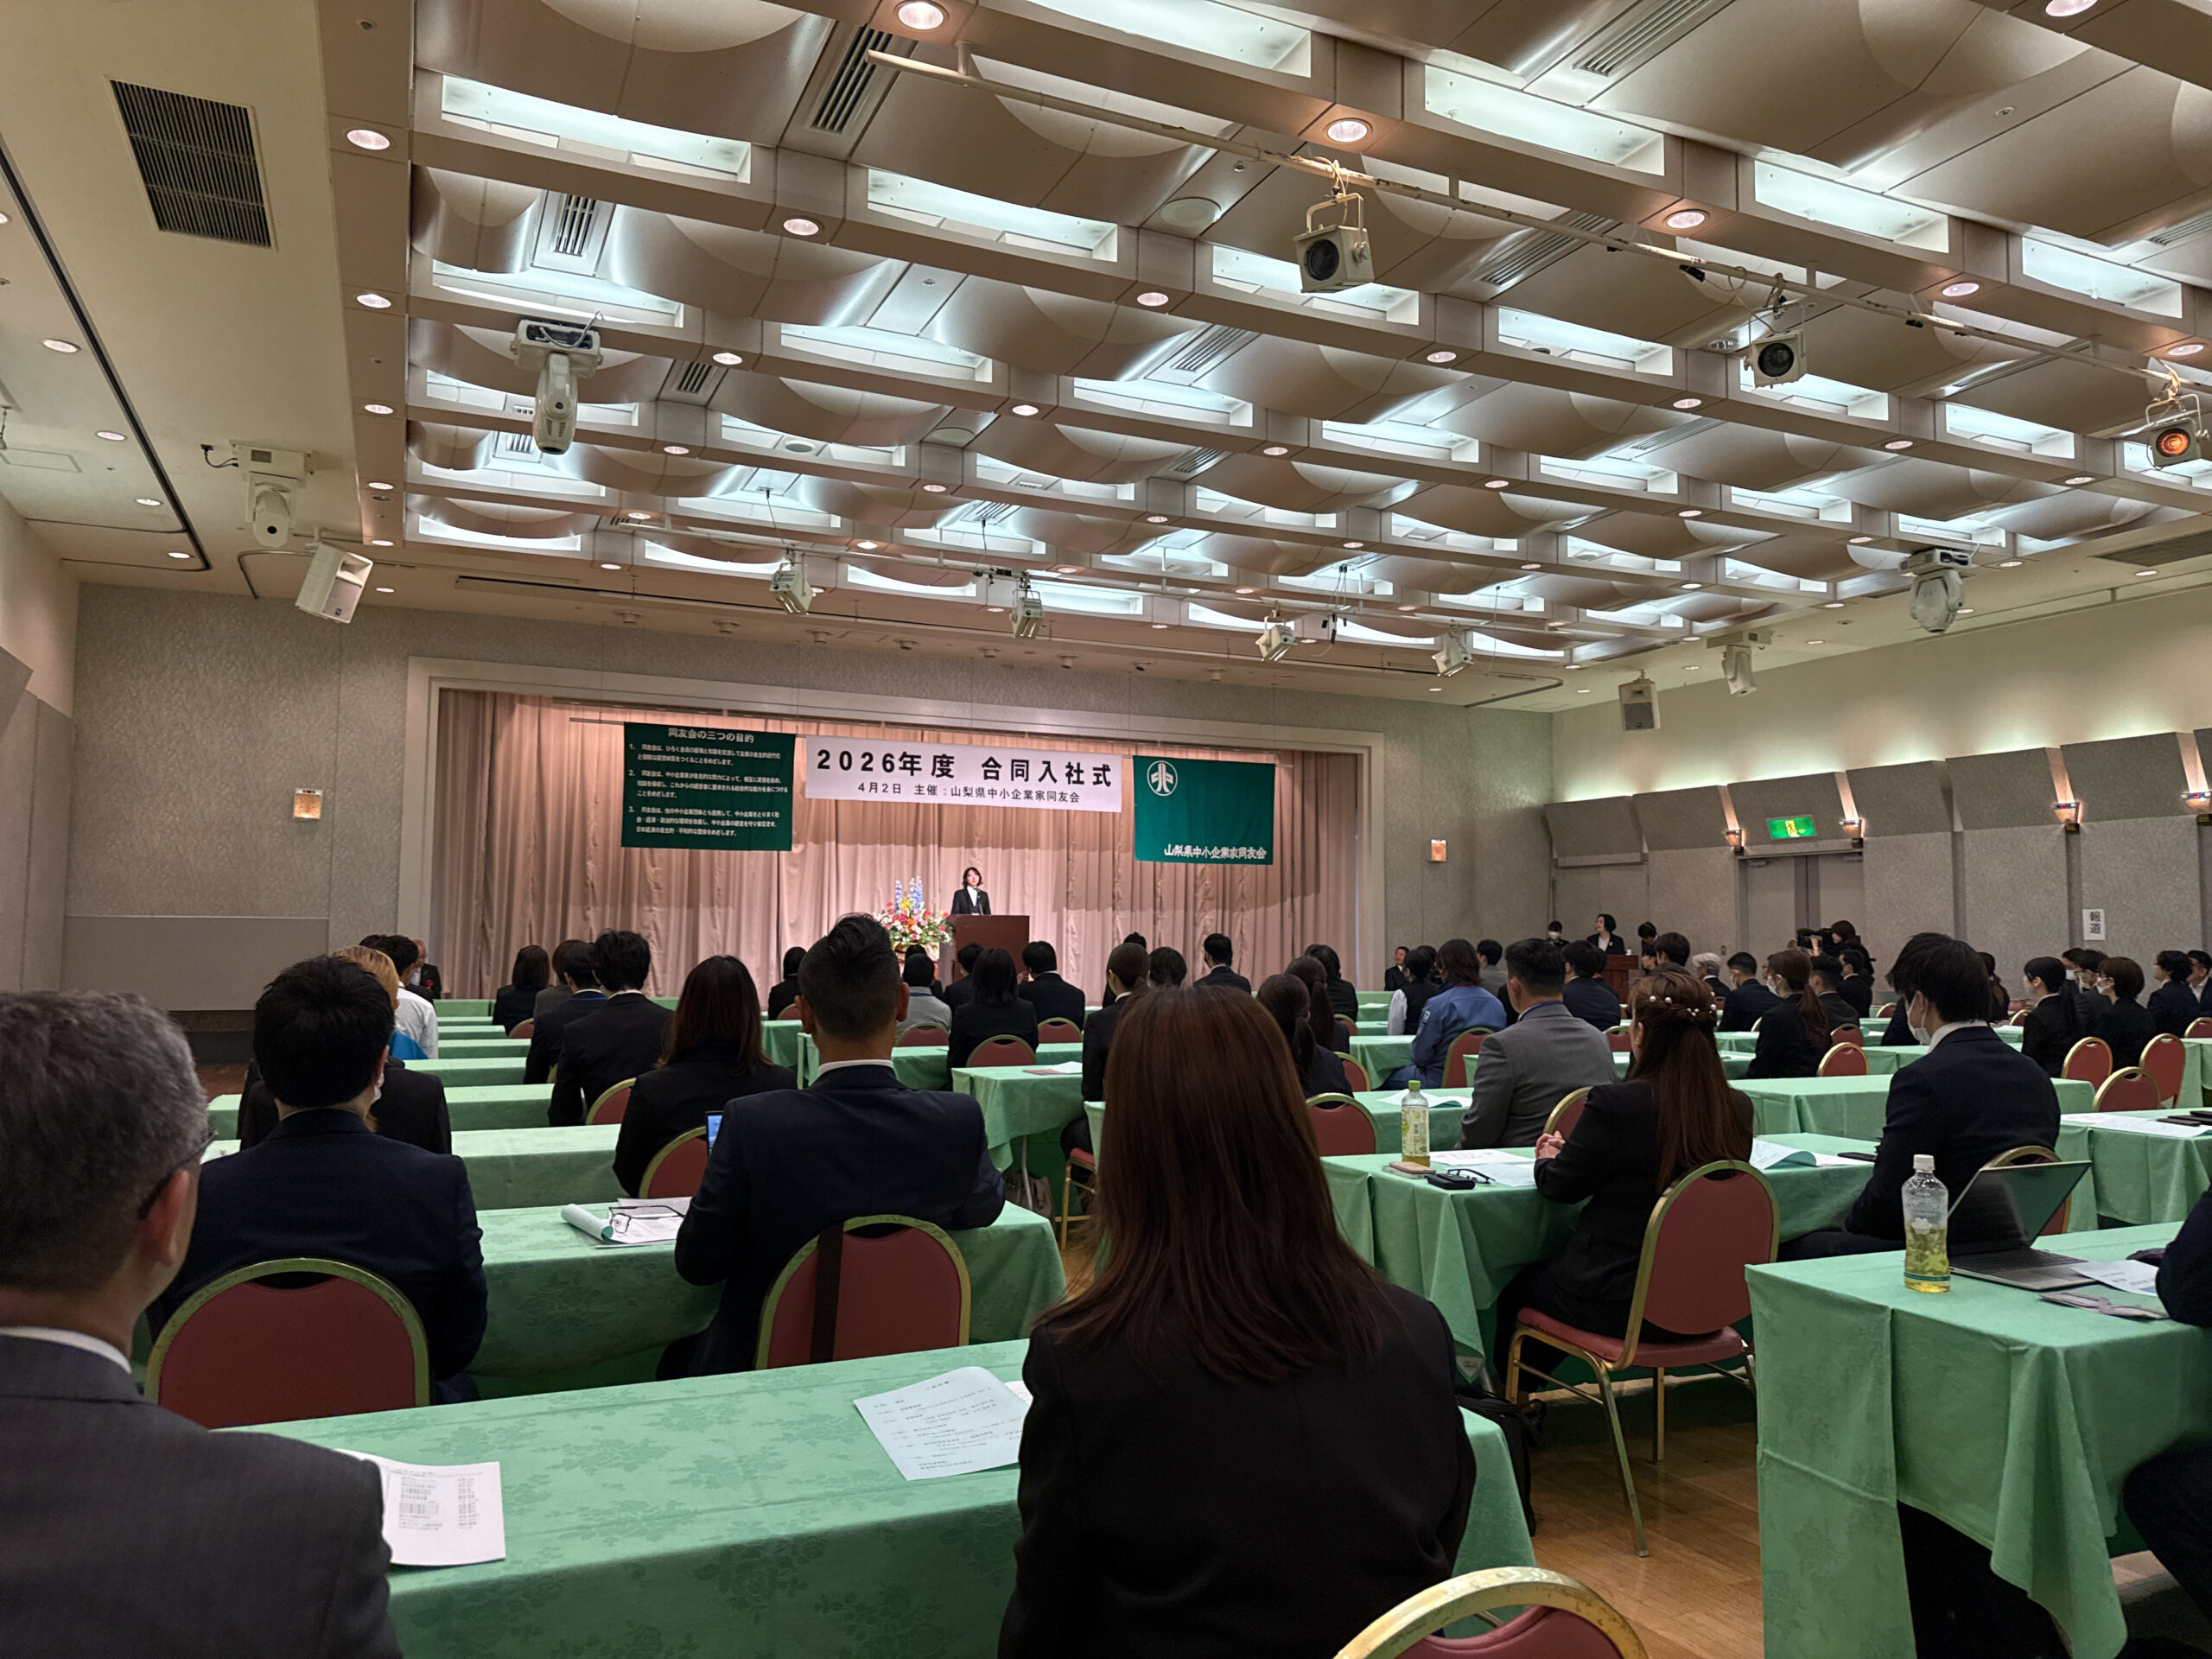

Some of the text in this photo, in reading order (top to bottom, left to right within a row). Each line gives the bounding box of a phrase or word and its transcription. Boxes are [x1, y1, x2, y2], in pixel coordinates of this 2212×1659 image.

[668, 728, 754, 744] 同友会の三つの目的
[817, 748, 1111, 787] 2026年度 合同入社式
[857, 782, 901, 794] 4月2日
[1163, 843, 1267, 860] 山梨県中小企業家同友会
[2089, 911, 2101, 934] 報道
